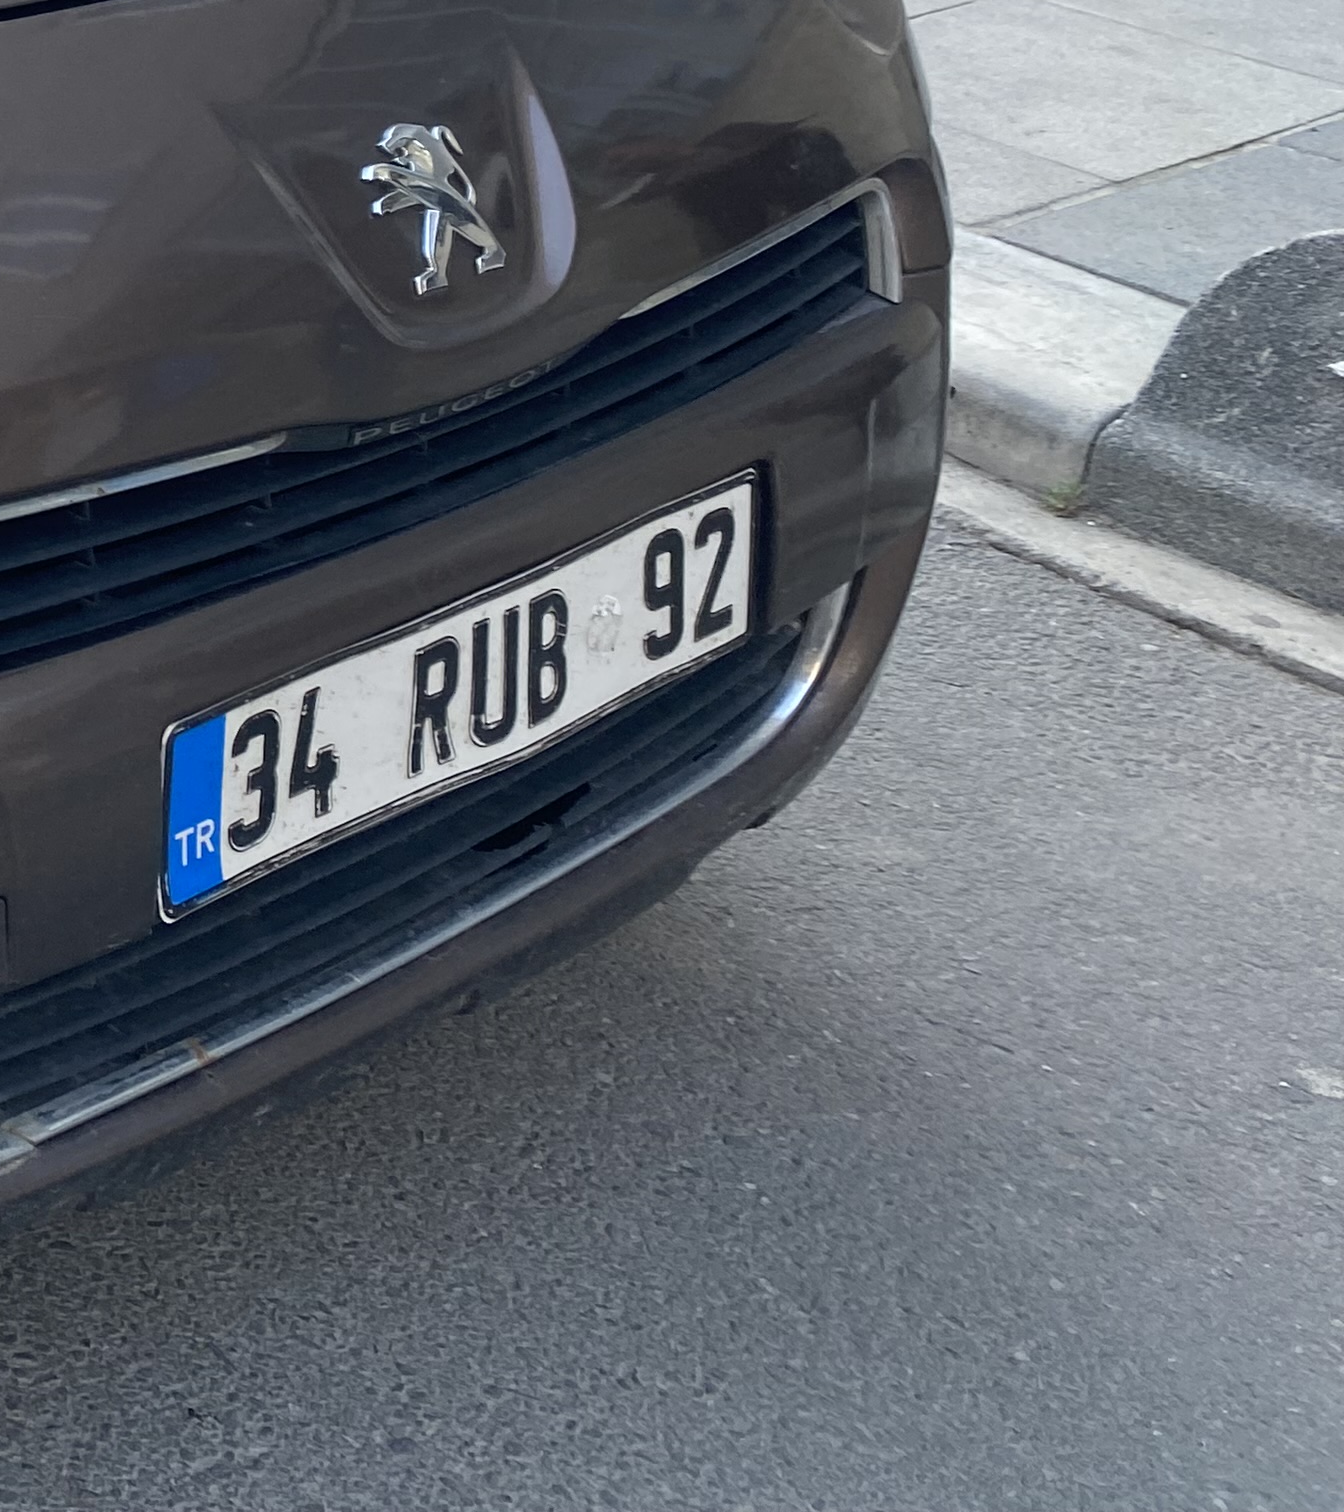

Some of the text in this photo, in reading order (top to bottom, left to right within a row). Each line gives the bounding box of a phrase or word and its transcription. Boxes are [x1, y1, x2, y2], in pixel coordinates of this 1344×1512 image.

[353, 360, 555, 446] PEUGEOT
[227, 507, 736, 852] 34 RUB 92
[175, 818, 216, 868] TR
